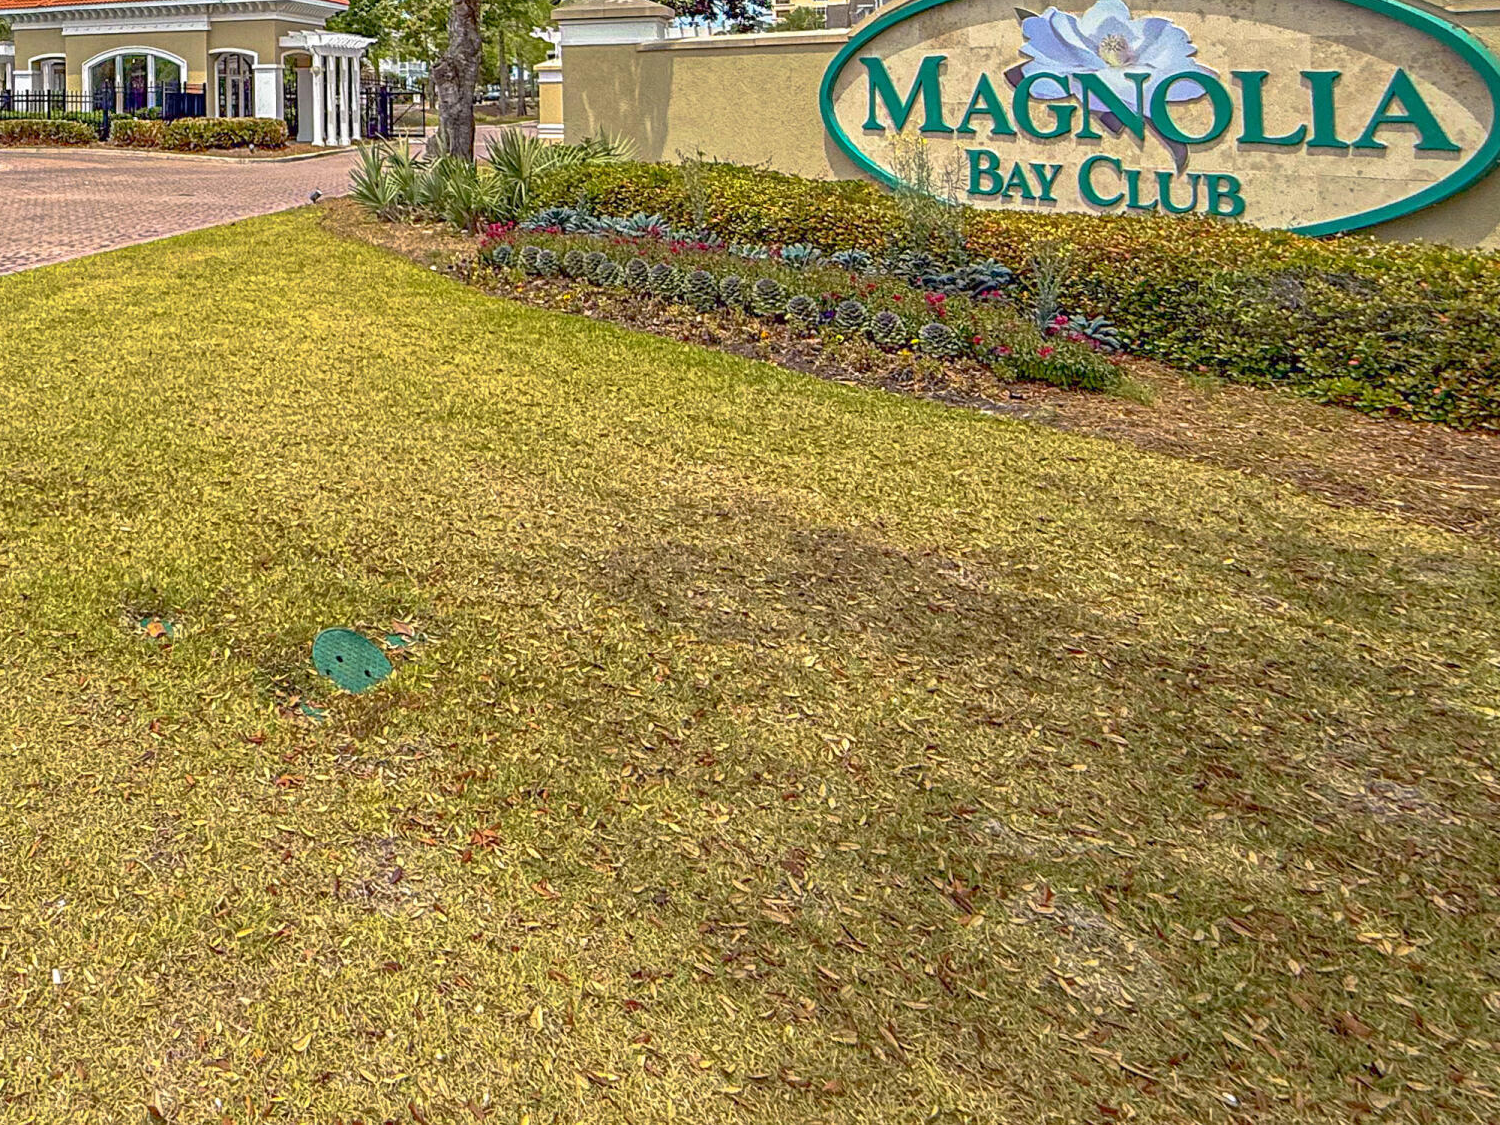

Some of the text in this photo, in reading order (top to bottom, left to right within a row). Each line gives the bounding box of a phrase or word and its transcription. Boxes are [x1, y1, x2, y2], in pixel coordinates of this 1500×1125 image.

[860, 54, 1462, 152] MAGNOLIA
[965, 148, 1247, 217] BAY CLUB
